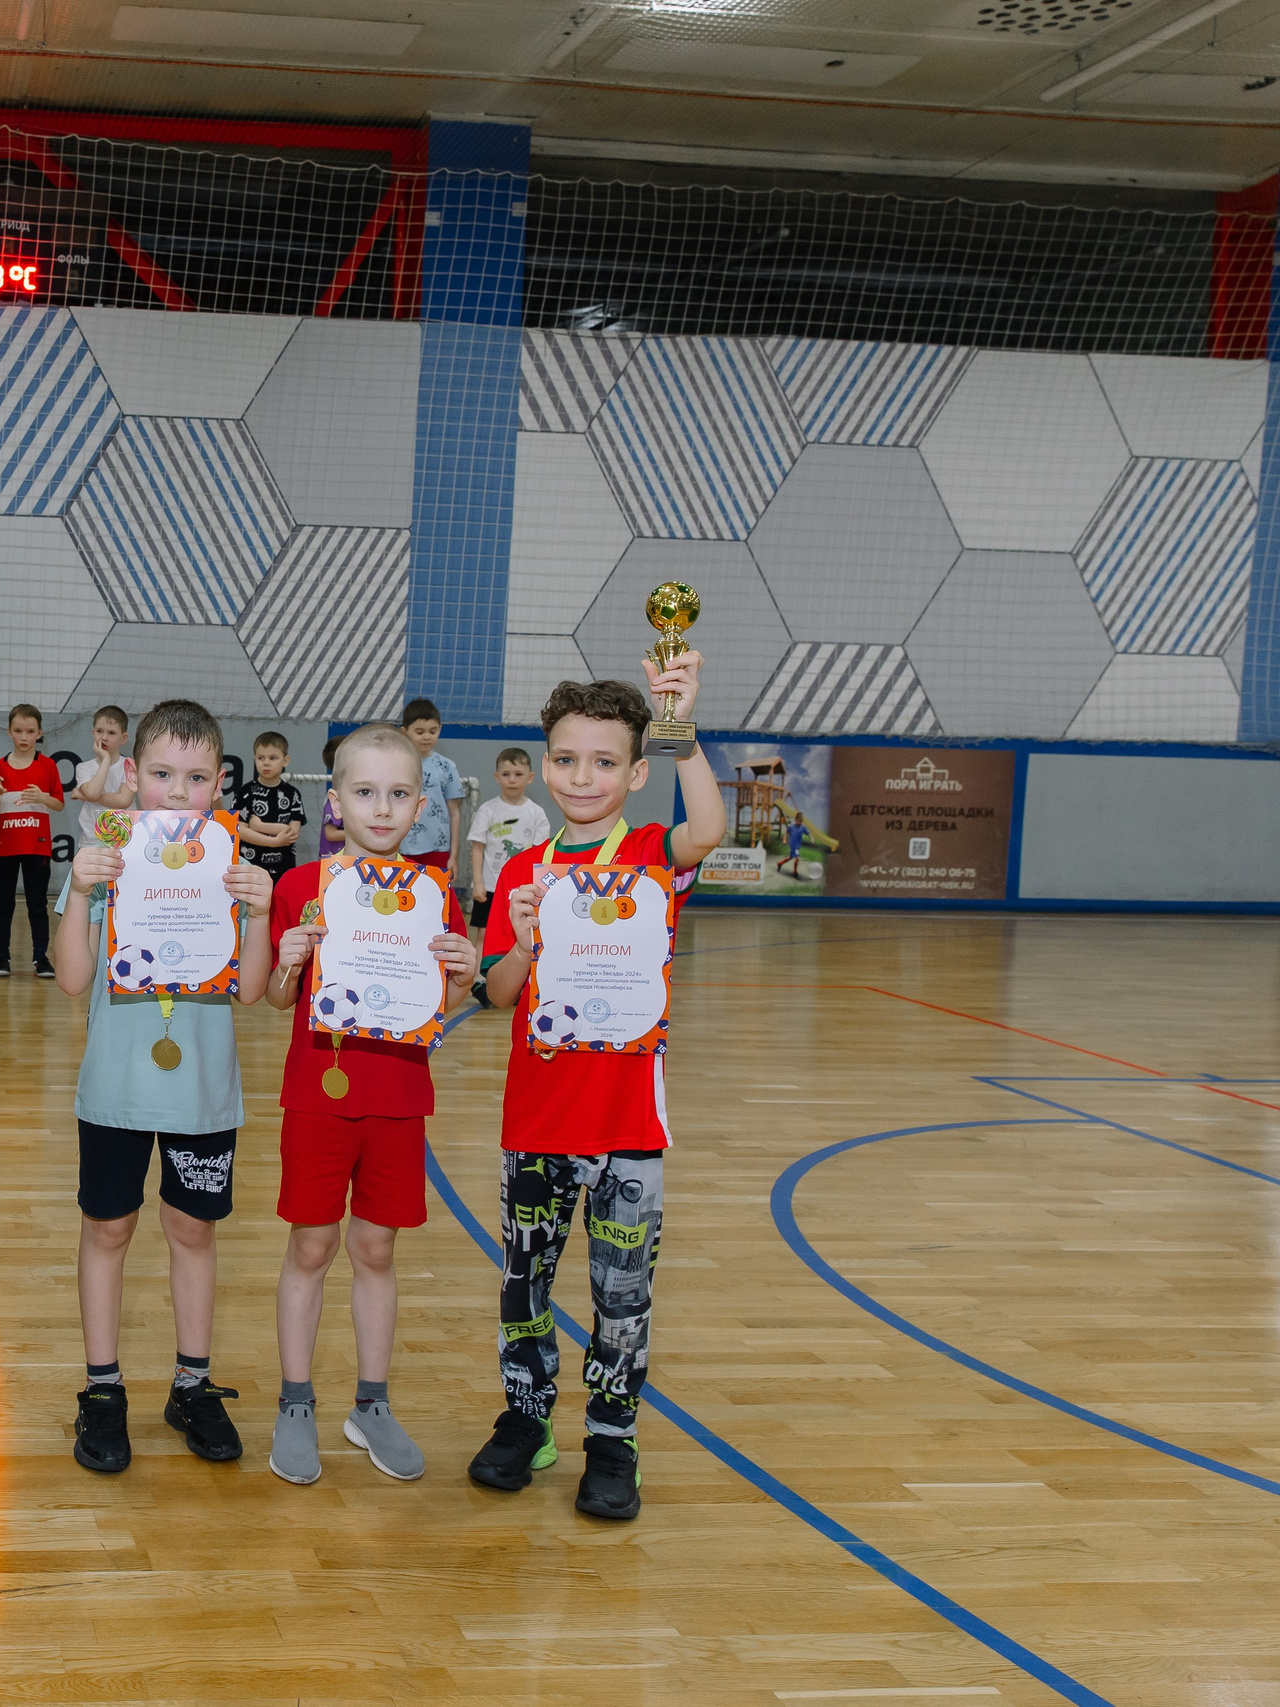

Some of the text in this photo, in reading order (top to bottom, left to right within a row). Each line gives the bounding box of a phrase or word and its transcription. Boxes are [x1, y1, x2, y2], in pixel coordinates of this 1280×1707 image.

[57, 254, 90, 265] ФОЛЫ
[885, 779, 963, 791] ПОРА ИГРАТЬ
[850, 804, 995, 818] ДЕТСКИЕ ПЛОЩАДКИ
[885, 820, 958, 831] ИЗ ДЕРЕВА
[144, 888, 201, 901] ДИПЛОМ
[353, 930, 410, 947] ДИПЛОМ
[368, 949, 396, 957] Чемпиону
[570, 944, 631, 957] ДИПЛОМ
[355, 955, 378, 963] турнира
[379, 958, 402, 966] «Звезды
[376, 965, 407, 973] дошкольных
[184, 1181, 224, 1193] LET'S SURF
[505, 1314, 551, 1338] FREE
